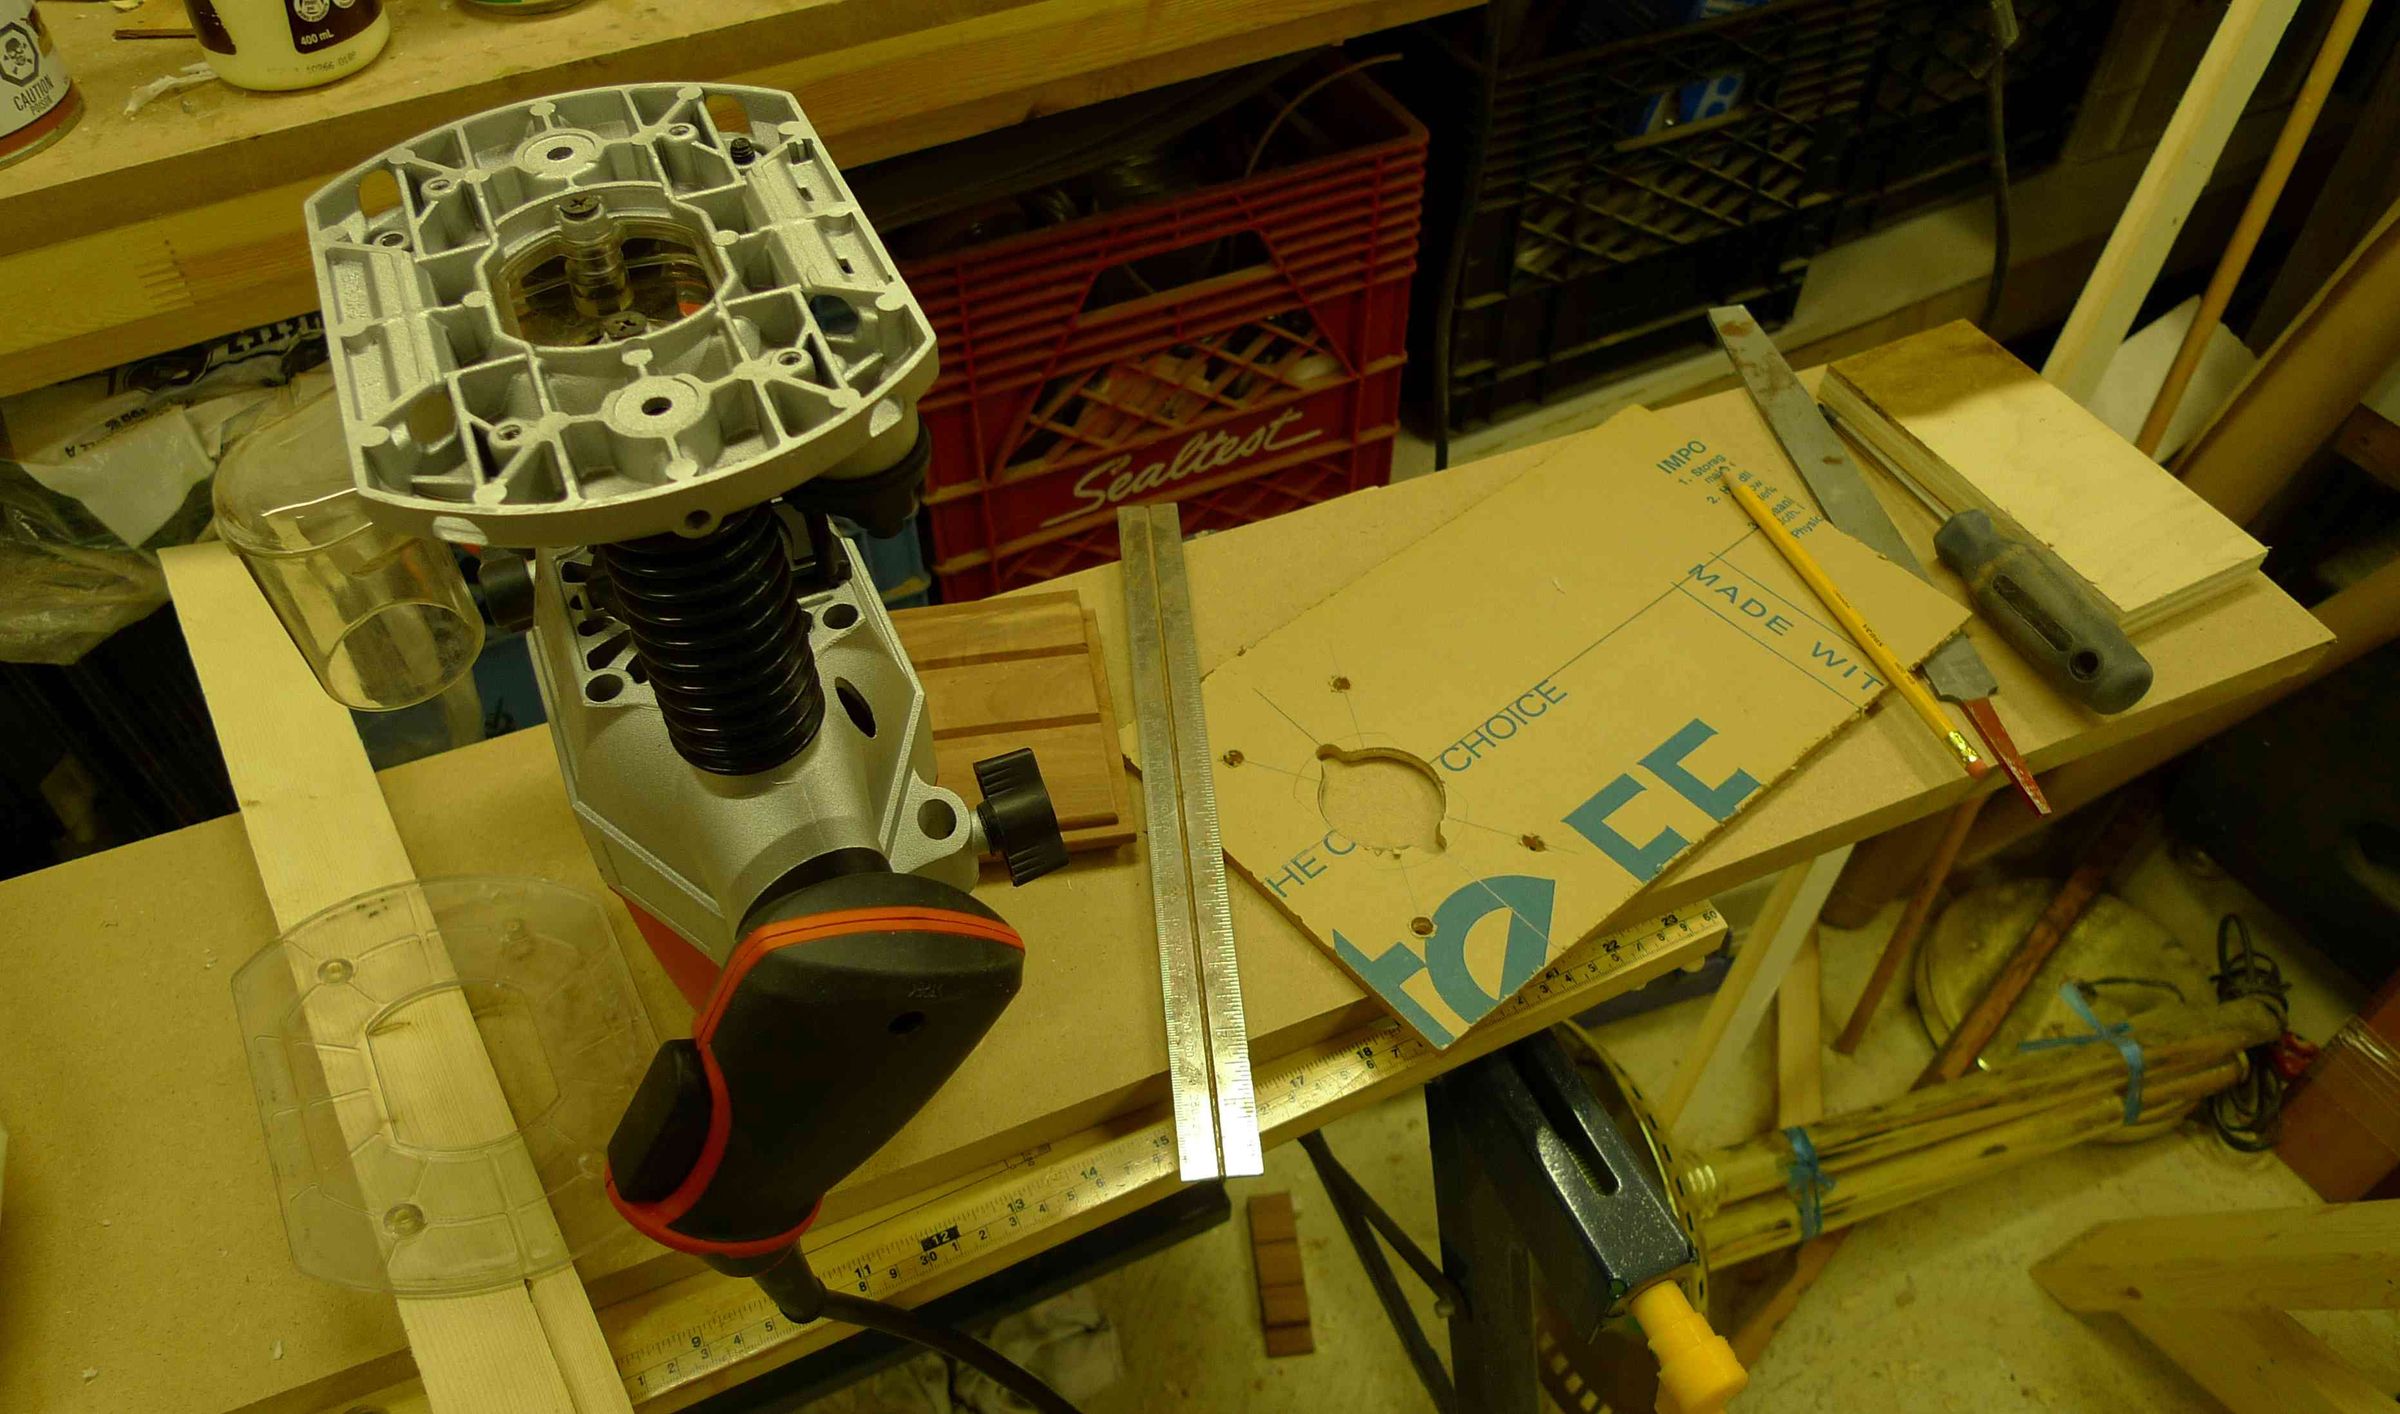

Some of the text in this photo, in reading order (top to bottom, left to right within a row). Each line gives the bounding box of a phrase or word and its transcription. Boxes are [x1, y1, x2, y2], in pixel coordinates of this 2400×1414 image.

[300, 29, 335, 46] 400 mL
[13, 74, 55, 112] CAUTION
[1040, 408, 1322, 527] Sealtest
[1656, 440, 1707, 475] IMPO
[1688, 563, 1885, 691] MADE WIT
[1439, 679, 1569, 773] CHOICE
[691, 1336, 701, 1348] 9
[854, 1263, 872, 1279] 11
[932, 1230, 951, 1245] 12
[1007, 1198, 1025, 1213] 13
[1080, 1166, 1098, 1180] 14
[1152, 1135, 1170, 1148] 15
[1290, 1075, 1305, 1088] 17
[1356, 1046, 1373, 1060] 18
[1603, 939, 1621, 953] 22
[858, 1281, 867, 1292] 8
[889, 1268, 898, 1279] 9
[919, 1250, 938, 1266] 30
[978, 1229, 988, 1241] 2
[1008, 1216, 1018, 1227] 3
[1039, 1203, 1047, 1213] 4
[1365, 1059, 1375, 1070] 6
